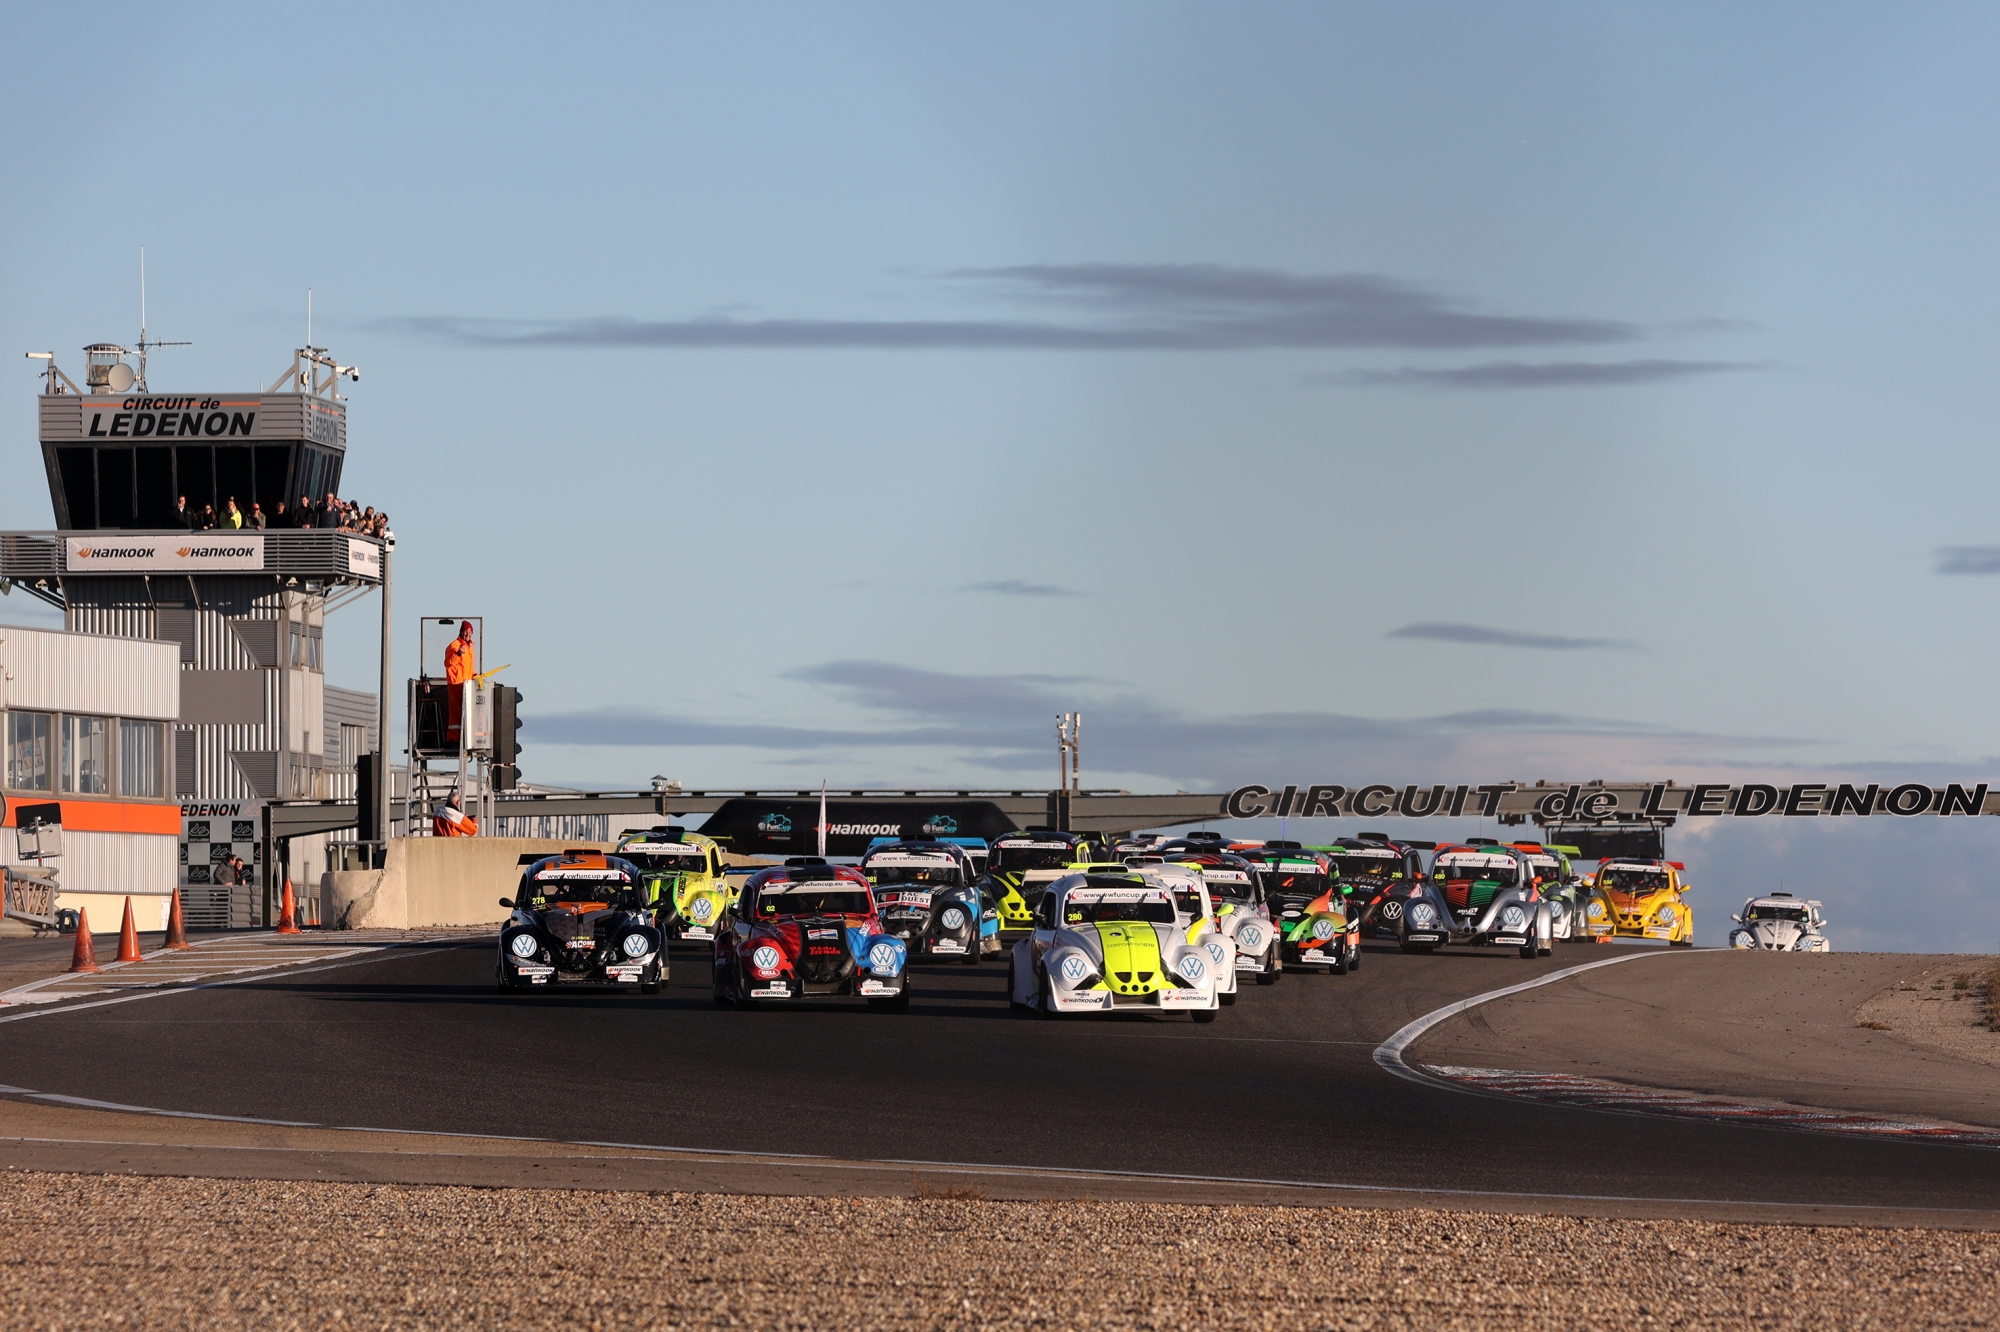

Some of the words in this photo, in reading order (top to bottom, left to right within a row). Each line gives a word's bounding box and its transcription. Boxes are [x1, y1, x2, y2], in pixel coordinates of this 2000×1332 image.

[122, 397, 196, 410] CIRCUIT
[200, 398, 220, 410] de
[88, 412, 256, 437] LEDENON
[91, 548, 155, 558] HANKOOK
[190, 547, 255, 558] HANKOOK
[1227, 784, 1518, 820] CIRCUIT
[1540, 784, 1620, 819] de
[1643, 782, 1989, 818] LEDENON
[830, 823, 900, 835] HANKOOK
[532, 896, 546, 905] 278
[1067, 913, 1083, 921] 280
